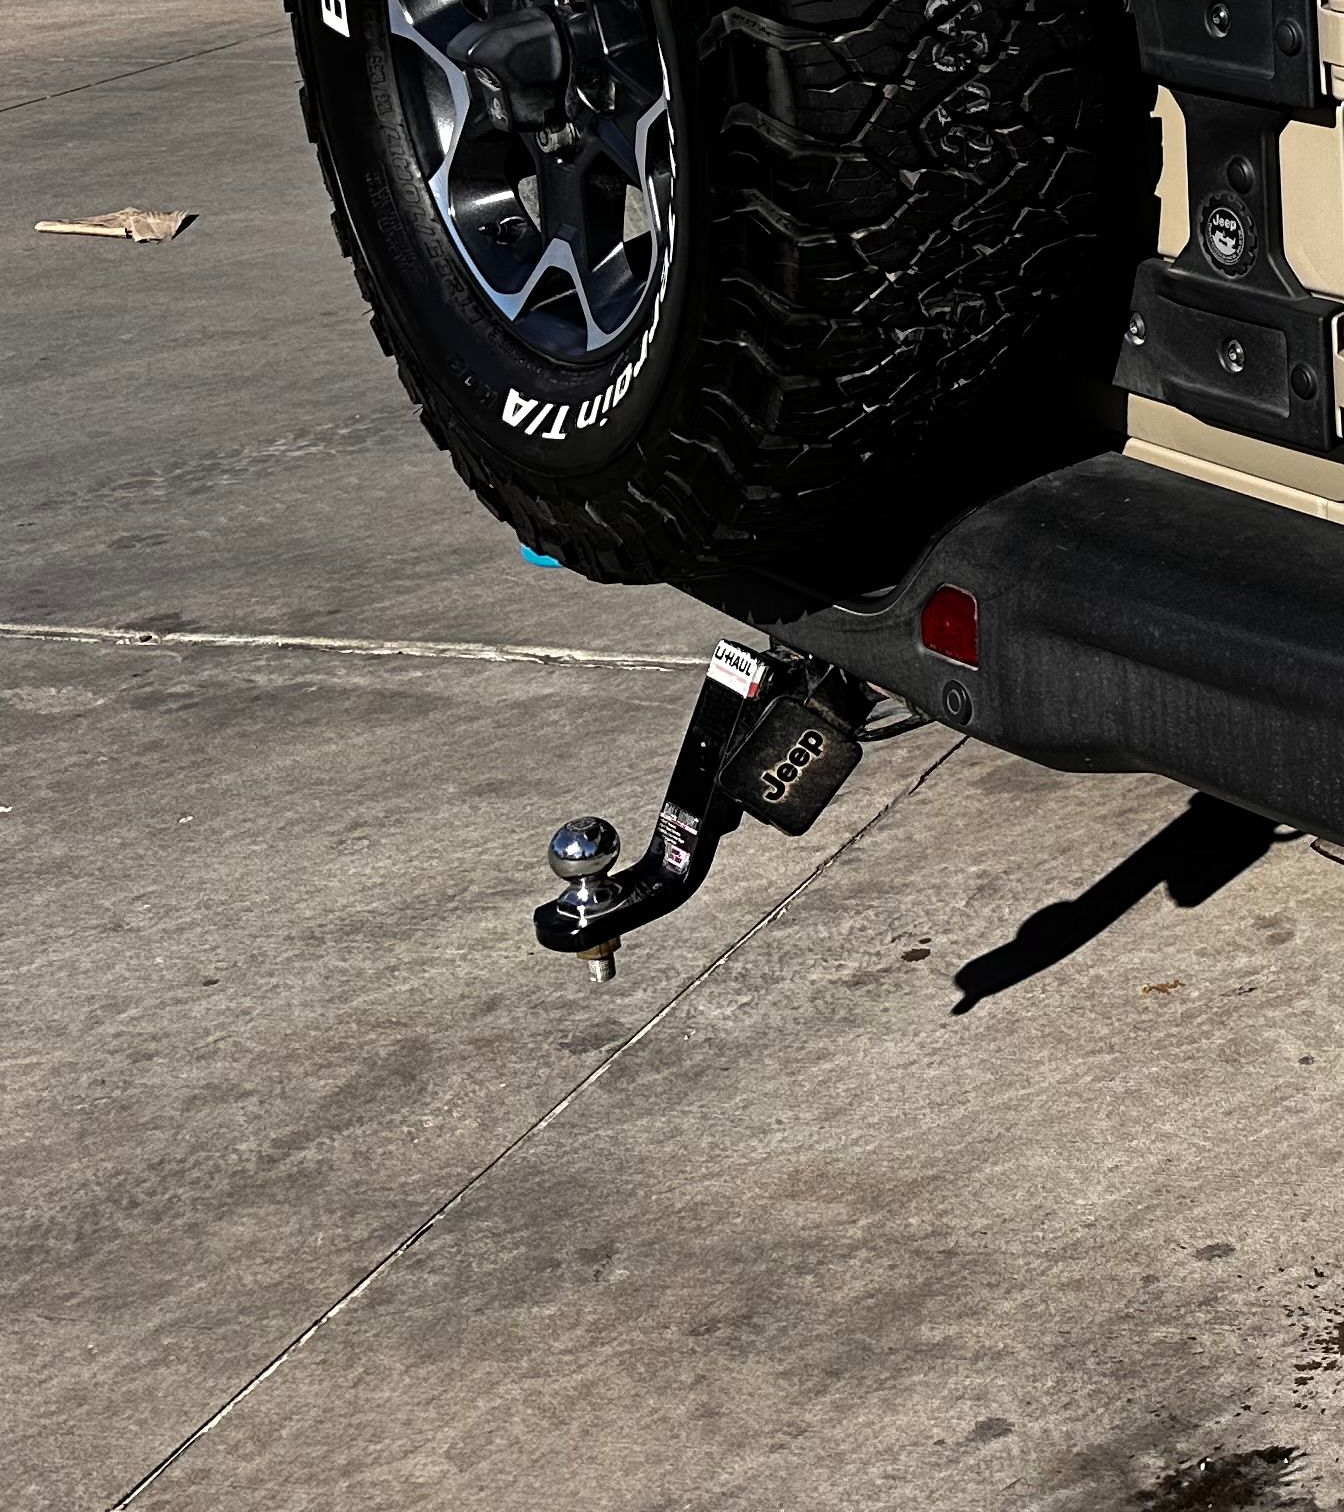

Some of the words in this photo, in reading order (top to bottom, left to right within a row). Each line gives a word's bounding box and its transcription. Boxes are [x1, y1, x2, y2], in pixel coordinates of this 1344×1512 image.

[1212, 213, 1237, 232] Jeep
[502, 387, 571, 441] T/A
[714, 644, 753, 677] U-HAUL
[762, 728, 825, 804] Jeep
